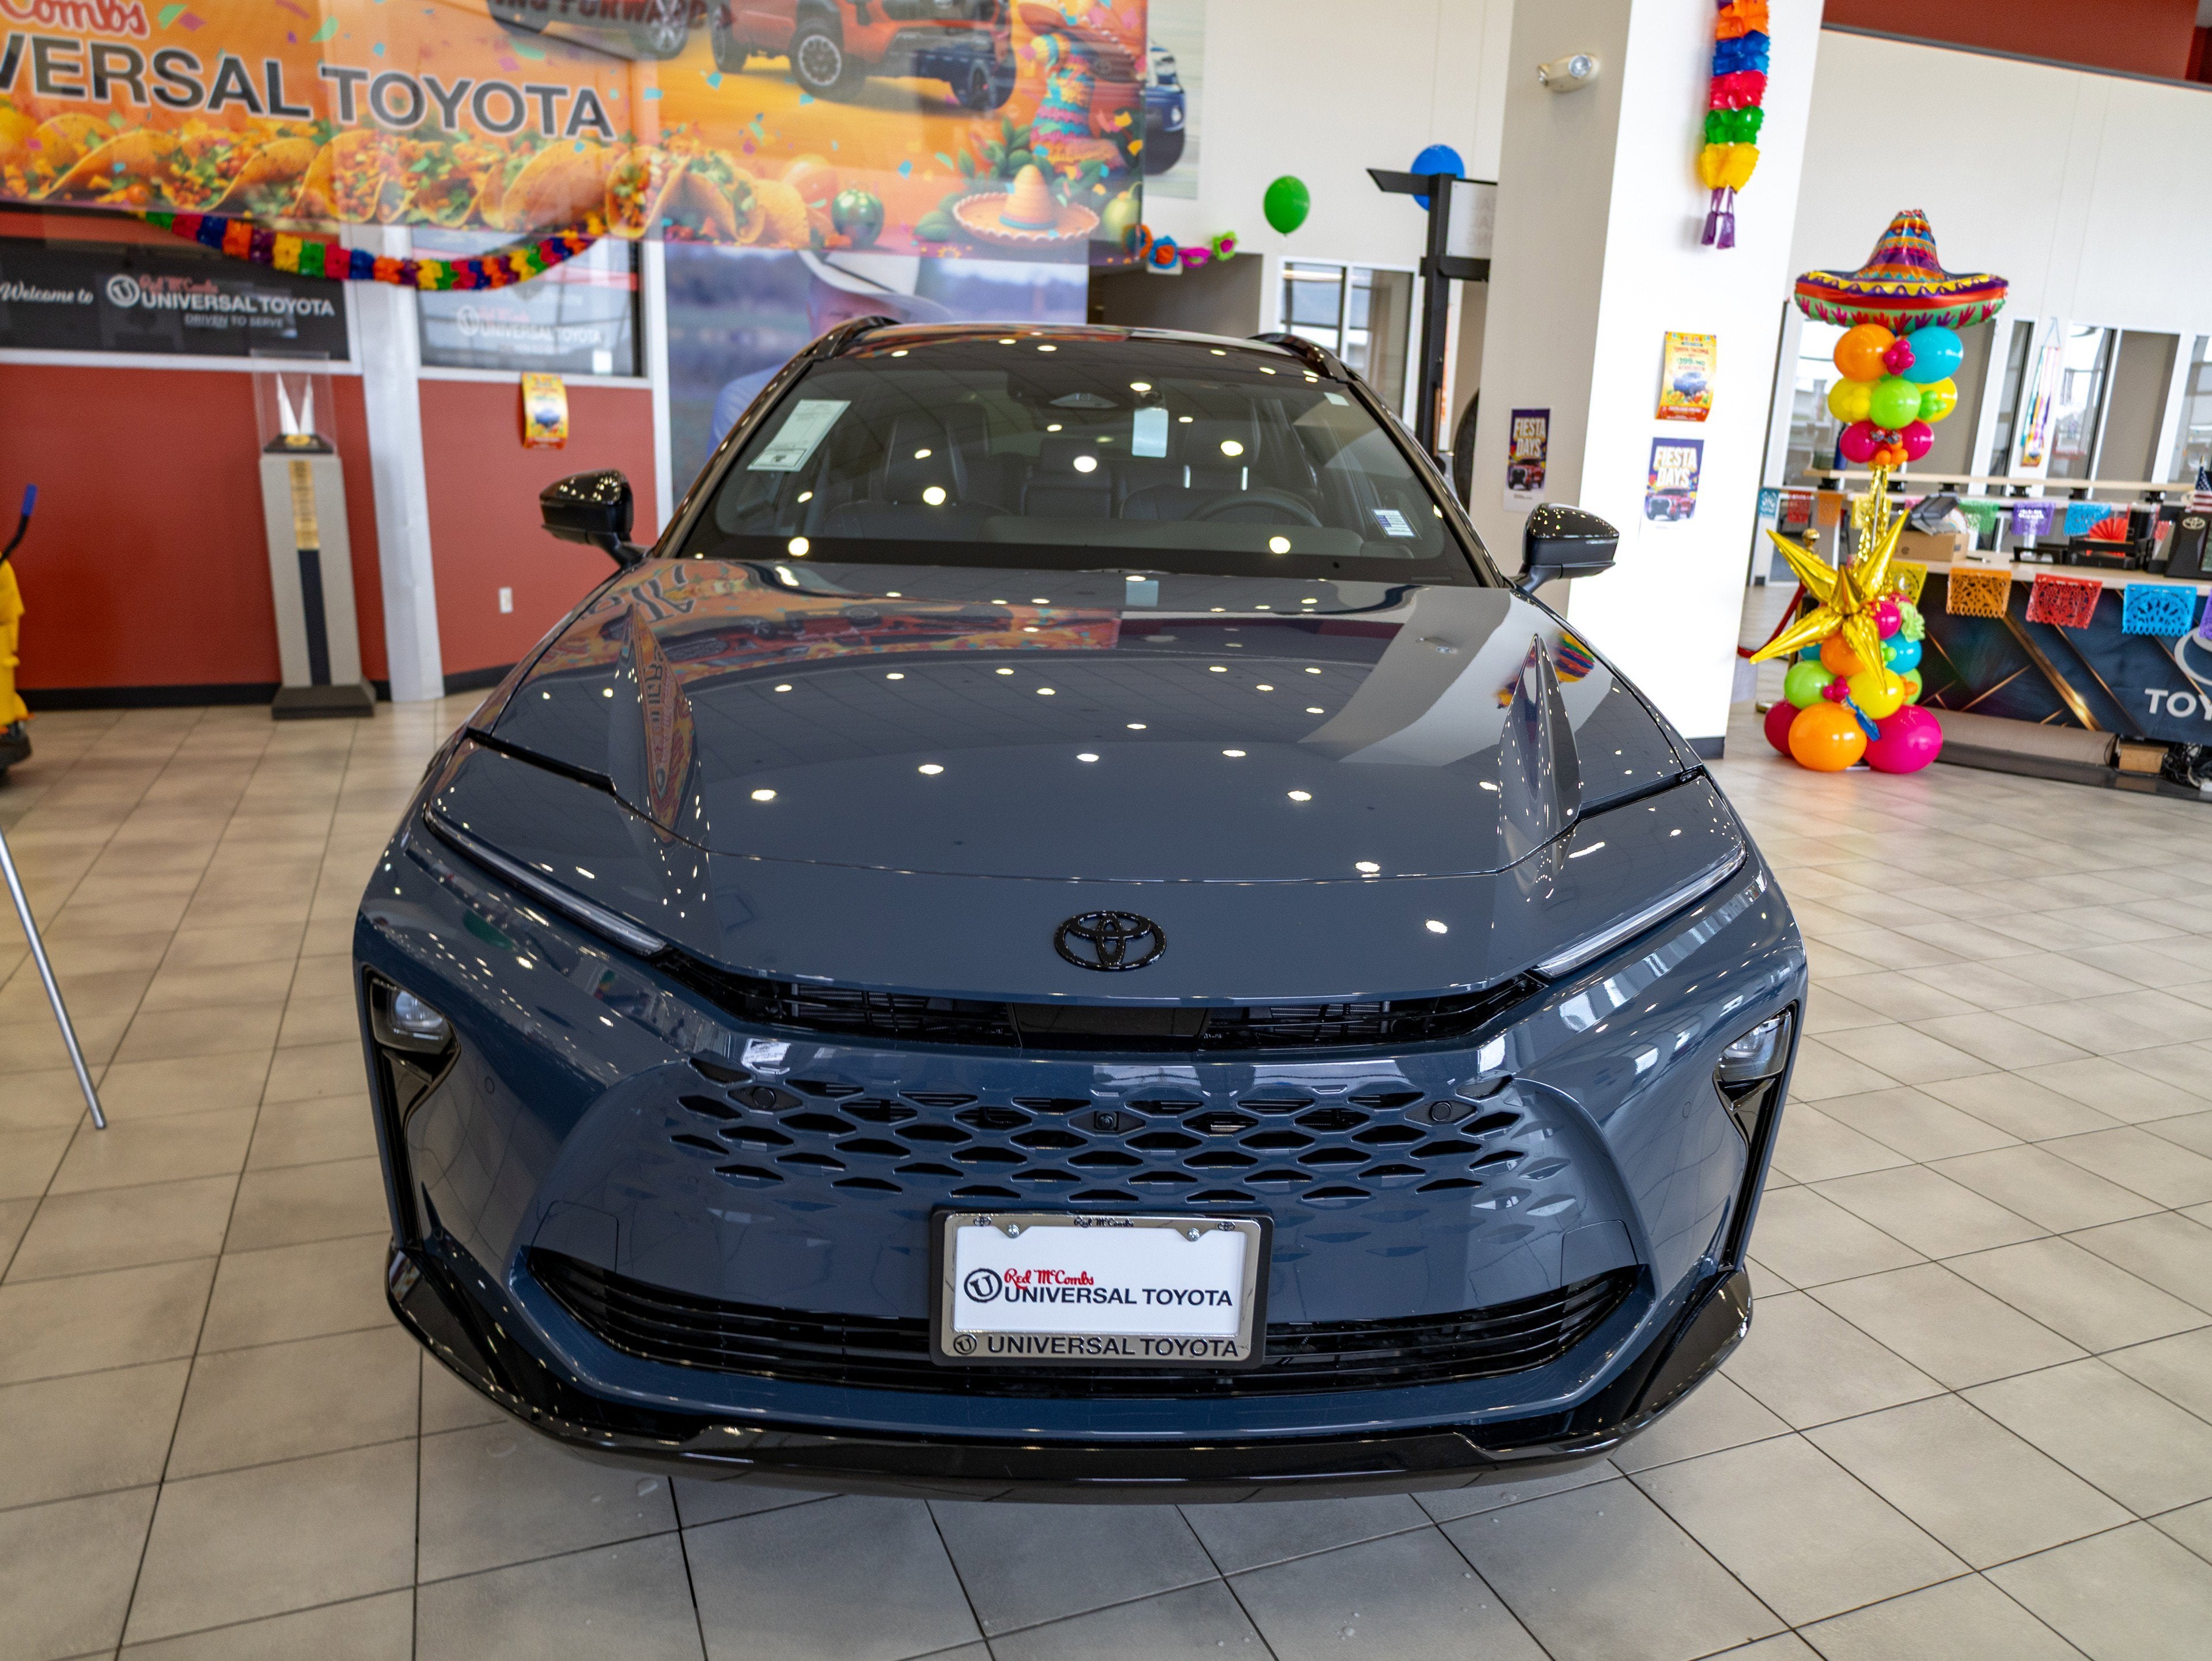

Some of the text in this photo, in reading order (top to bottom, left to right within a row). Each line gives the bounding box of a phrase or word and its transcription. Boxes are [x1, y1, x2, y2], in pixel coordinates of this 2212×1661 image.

[321, 65, 615, 138] TOYOTA
[0, 279, 94, 305] Welcome to
[142, 292, 335, 317] UNIVERSAL TOYOTA
[1513, 417, 1546, 441] FIESTA
[1516, 438, 1541, 459] DAYS
[1653, 446, 1698, 471] FIESTA
[1656, 467, 1691, 488] DAYS
[1004, 1268, 1094, 1290] Red McCombs
[1005, 1287, 1233, 1307] UNIVERSAL TOYOTA
[987, 1335, 1135, 1356] UNIVERSAL
[1141, 1338, 1239, 1358] TOYOTA
